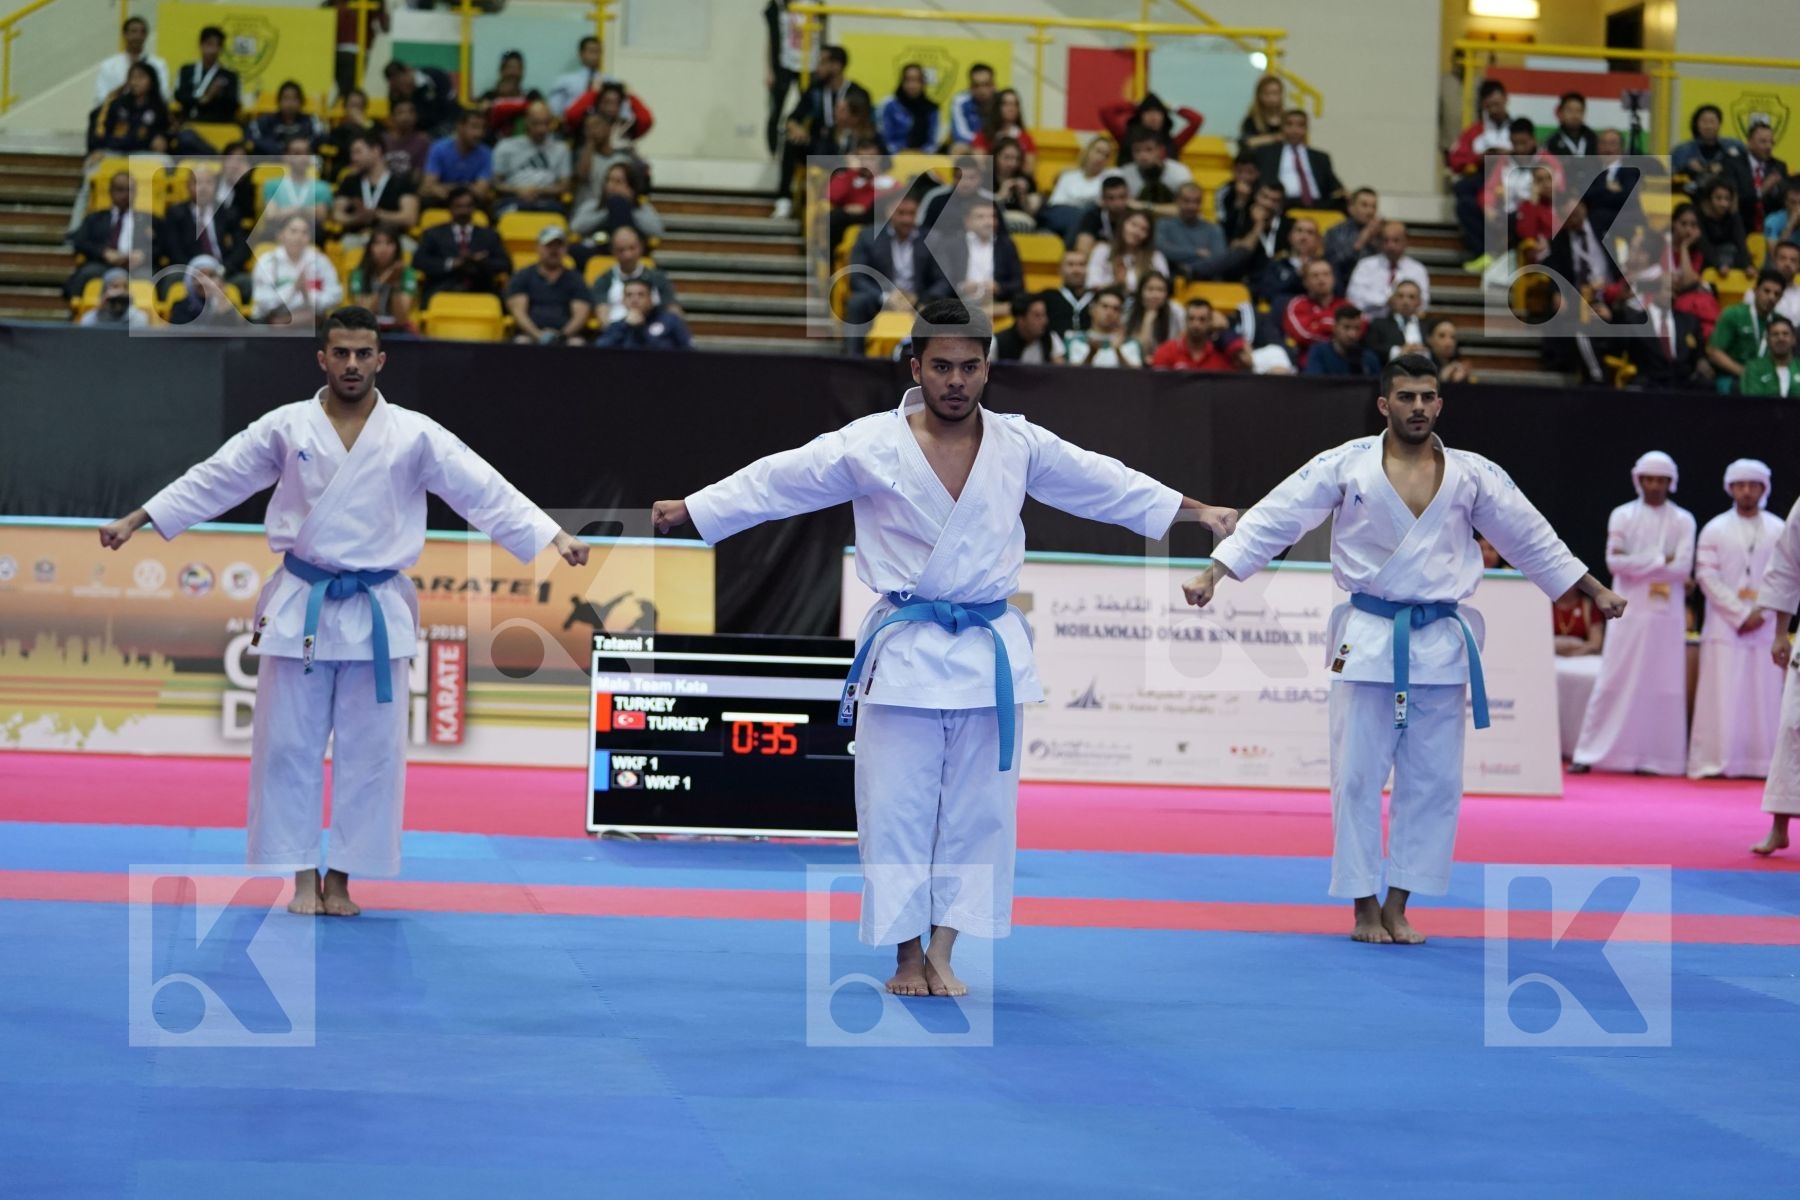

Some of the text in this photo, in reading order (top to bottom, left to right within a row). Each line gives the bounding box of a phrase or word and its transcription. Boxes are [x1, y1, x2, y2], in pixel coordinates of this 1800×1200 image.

[1054, 623, 1152, 640] MOHAMMAD
[1156, 625, 1204, 642] OMAR
[1241, 628, 1303, 645] HAIDER
[594, 636, 654, 651] Tatami 1
[435, 644, 461, 742] KARATE
[597, 677, 708, 694] Male Team Kata
[613, 696, 677, 712] TURKEY
[647, 715, 709, 732] TURKEY
[732, 720, 798, 755] 0:35
[611, 755, 659, 771] WKF 1
[645, 774, 692, 791] WKF 1
